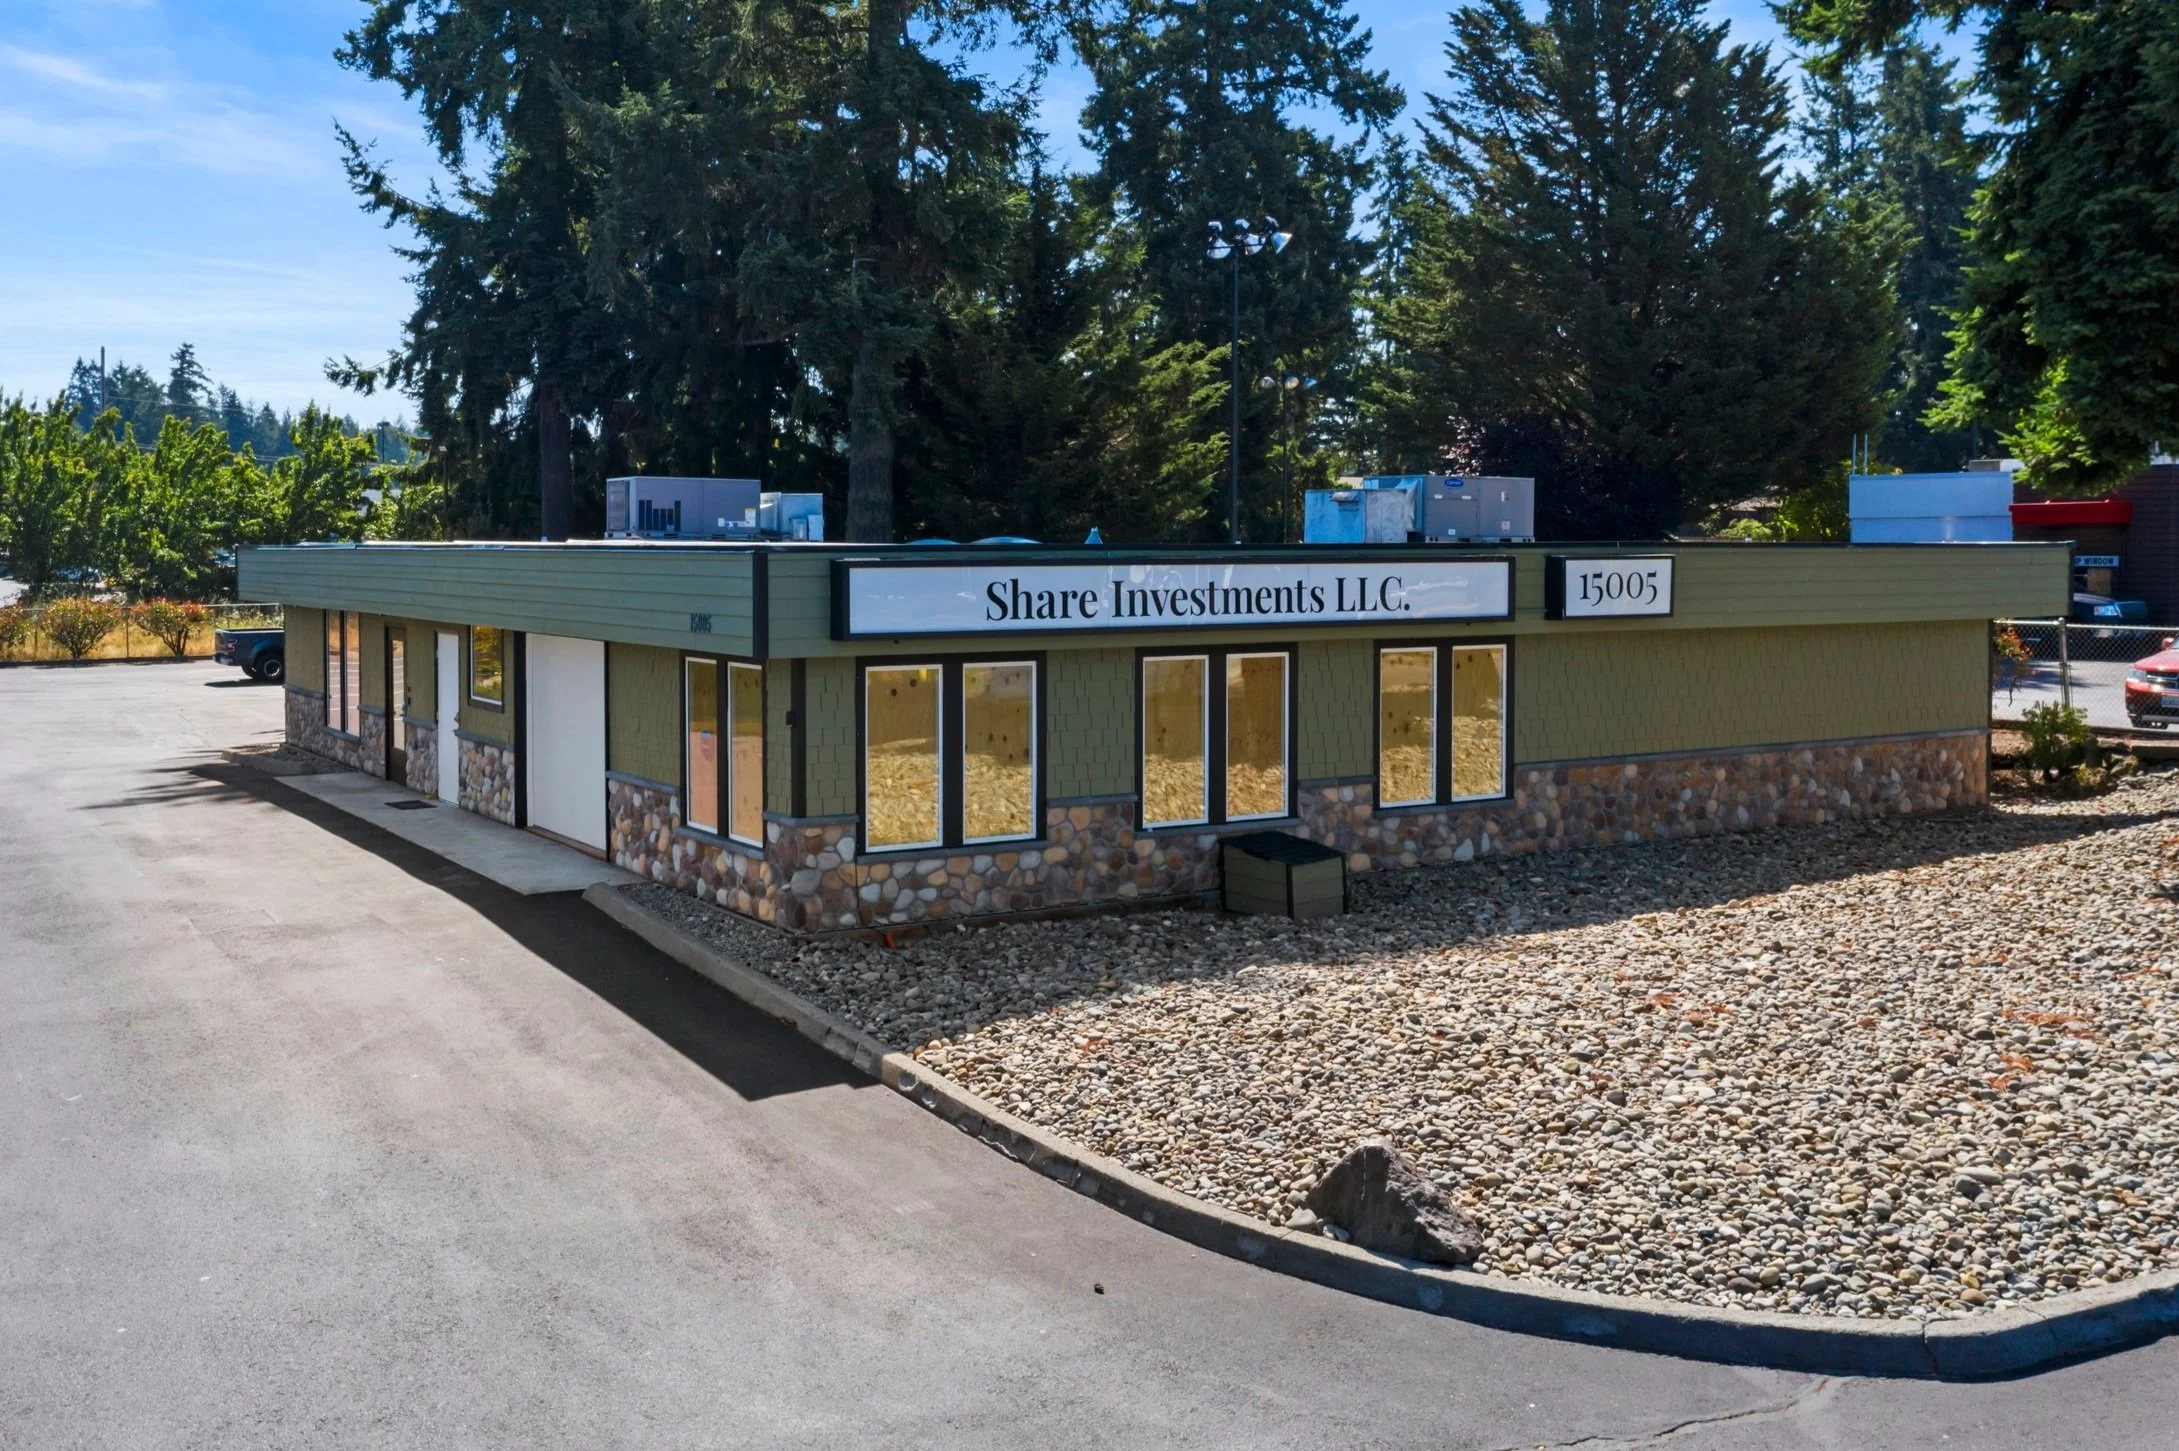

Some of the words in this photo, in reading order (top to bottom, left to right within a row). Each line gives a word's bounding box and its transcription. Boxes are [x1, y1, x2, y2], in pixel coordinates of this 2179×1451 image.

[2084, 557, 2115, 566] WINDOW
[986, 578, 1098, 621] Share
[1112, 579, 1325, 618] Investments
[1335, 576, 1410, 612] LLC.
[1579, 570, 1658, 607] 15005
[690, 613, 712, 634] 15005
